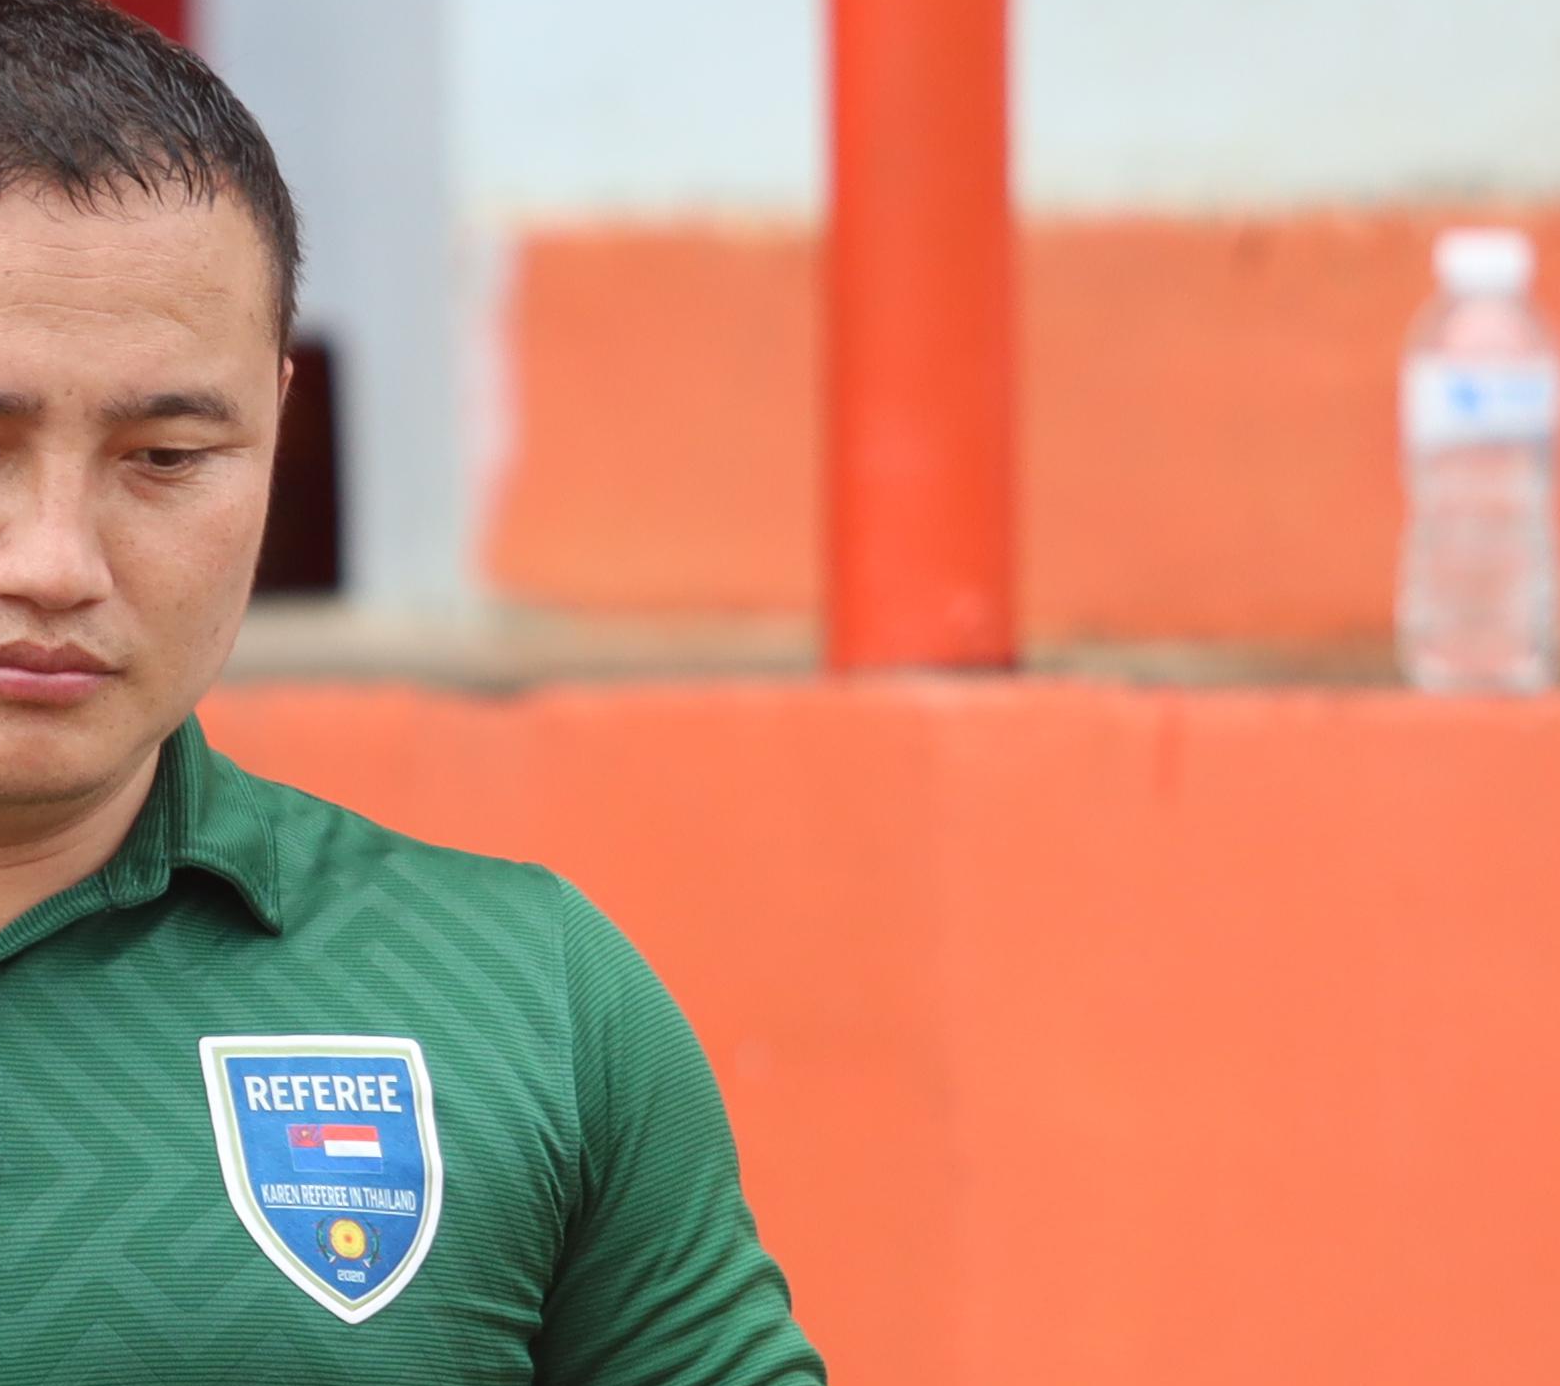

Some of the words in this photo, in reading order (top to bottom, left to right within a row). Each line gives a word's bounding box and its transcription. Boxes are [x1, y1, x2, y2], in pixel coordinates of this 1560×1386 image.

[243, 1075, 402, 1113] REFEREE
[261, 1183, 300, 1204] KAREN
[301, 1185, 349, 1206] REFEREE
[350, 1187, 363, 1207] IN
[363, 1188, 416, 1211] THAILAND
